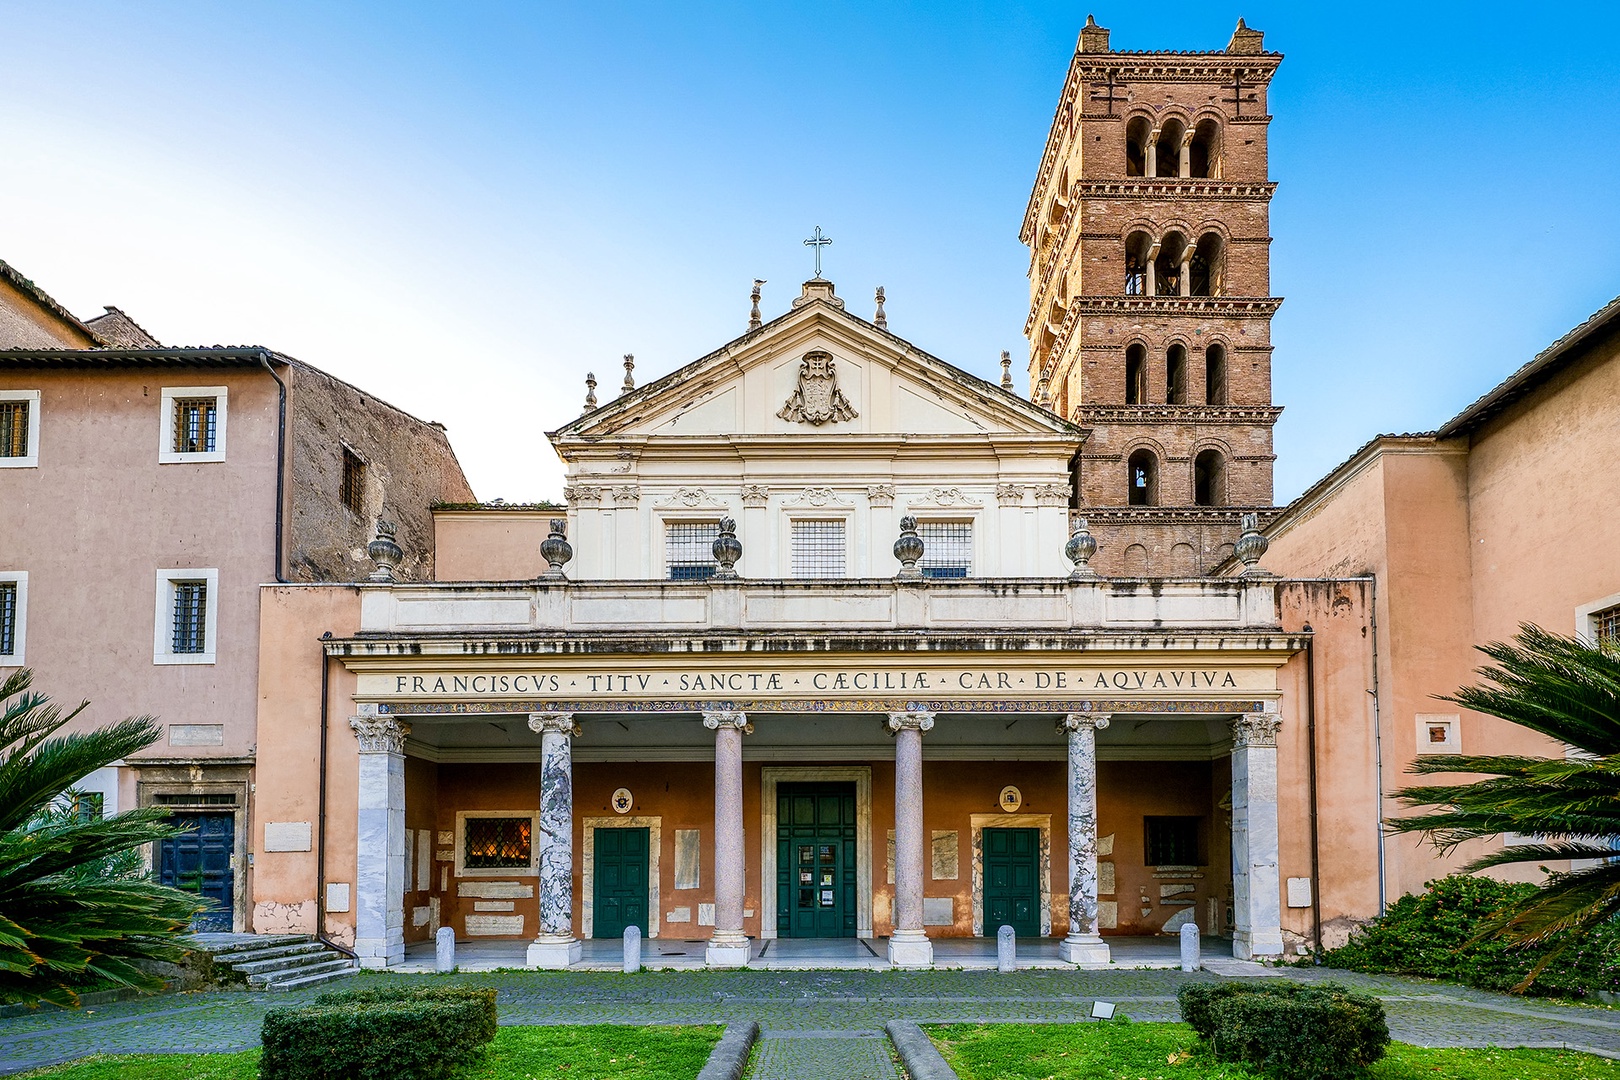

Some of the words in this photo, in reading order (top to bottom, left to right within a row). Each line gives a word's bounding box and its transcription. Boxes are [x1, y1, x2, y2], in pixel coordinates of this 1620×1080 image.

[395, 674, 560, 694] FRANCISCVS
[586, 673, 652, 693] TITV
[679, 673, 785, 692] SANCTÆ
[813, 671, 932, 691] CÆCILIÆ
[958, 672, 1014, 690] CAR
[1034, 671, 1068, 690] DE
[1093, 670, 1238, 691] AQVAVIVA
